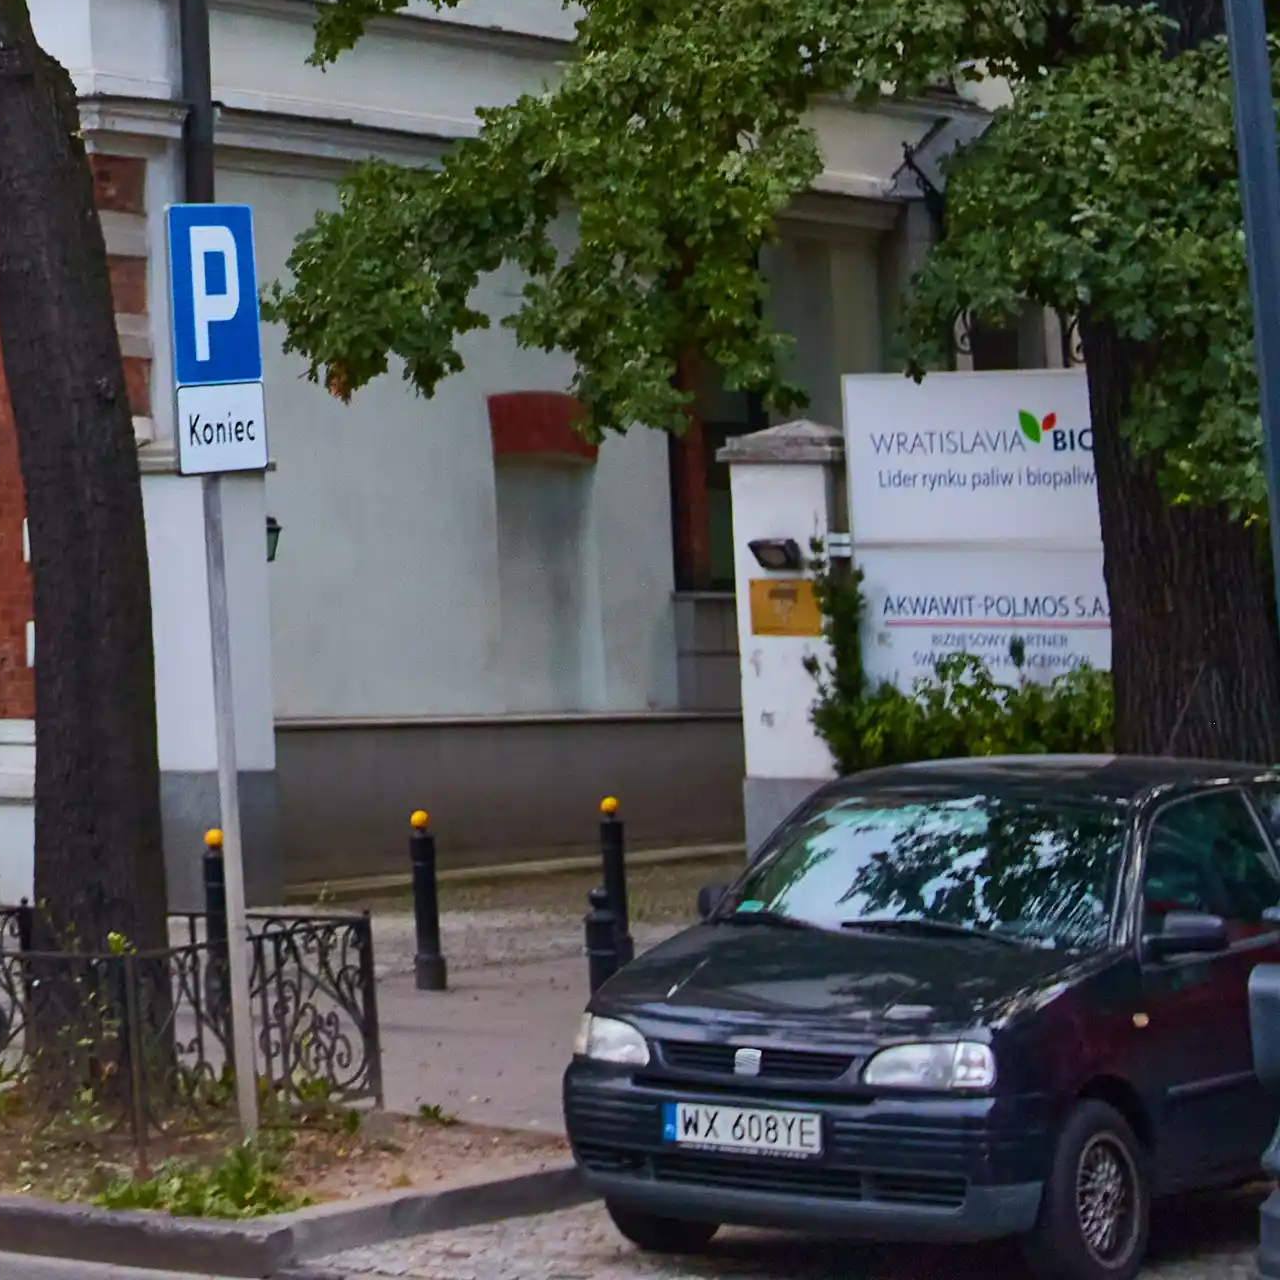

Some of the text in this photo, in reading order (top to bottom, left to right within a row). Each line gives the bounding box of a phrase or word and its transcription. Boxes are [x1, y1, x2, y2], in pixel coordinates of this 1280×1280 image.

[189, 225, 240, 362] P
[189, 411, 256, 446] Koniec
[869, 429, 1026, 455] WRATISLAVIA
[878, 468, 917, 488] Lider
[922, 467, 967, 491] rynku
[972, 466, 1014, 490] paliw
[681, 1107, 816, 1148] WX 608YE
